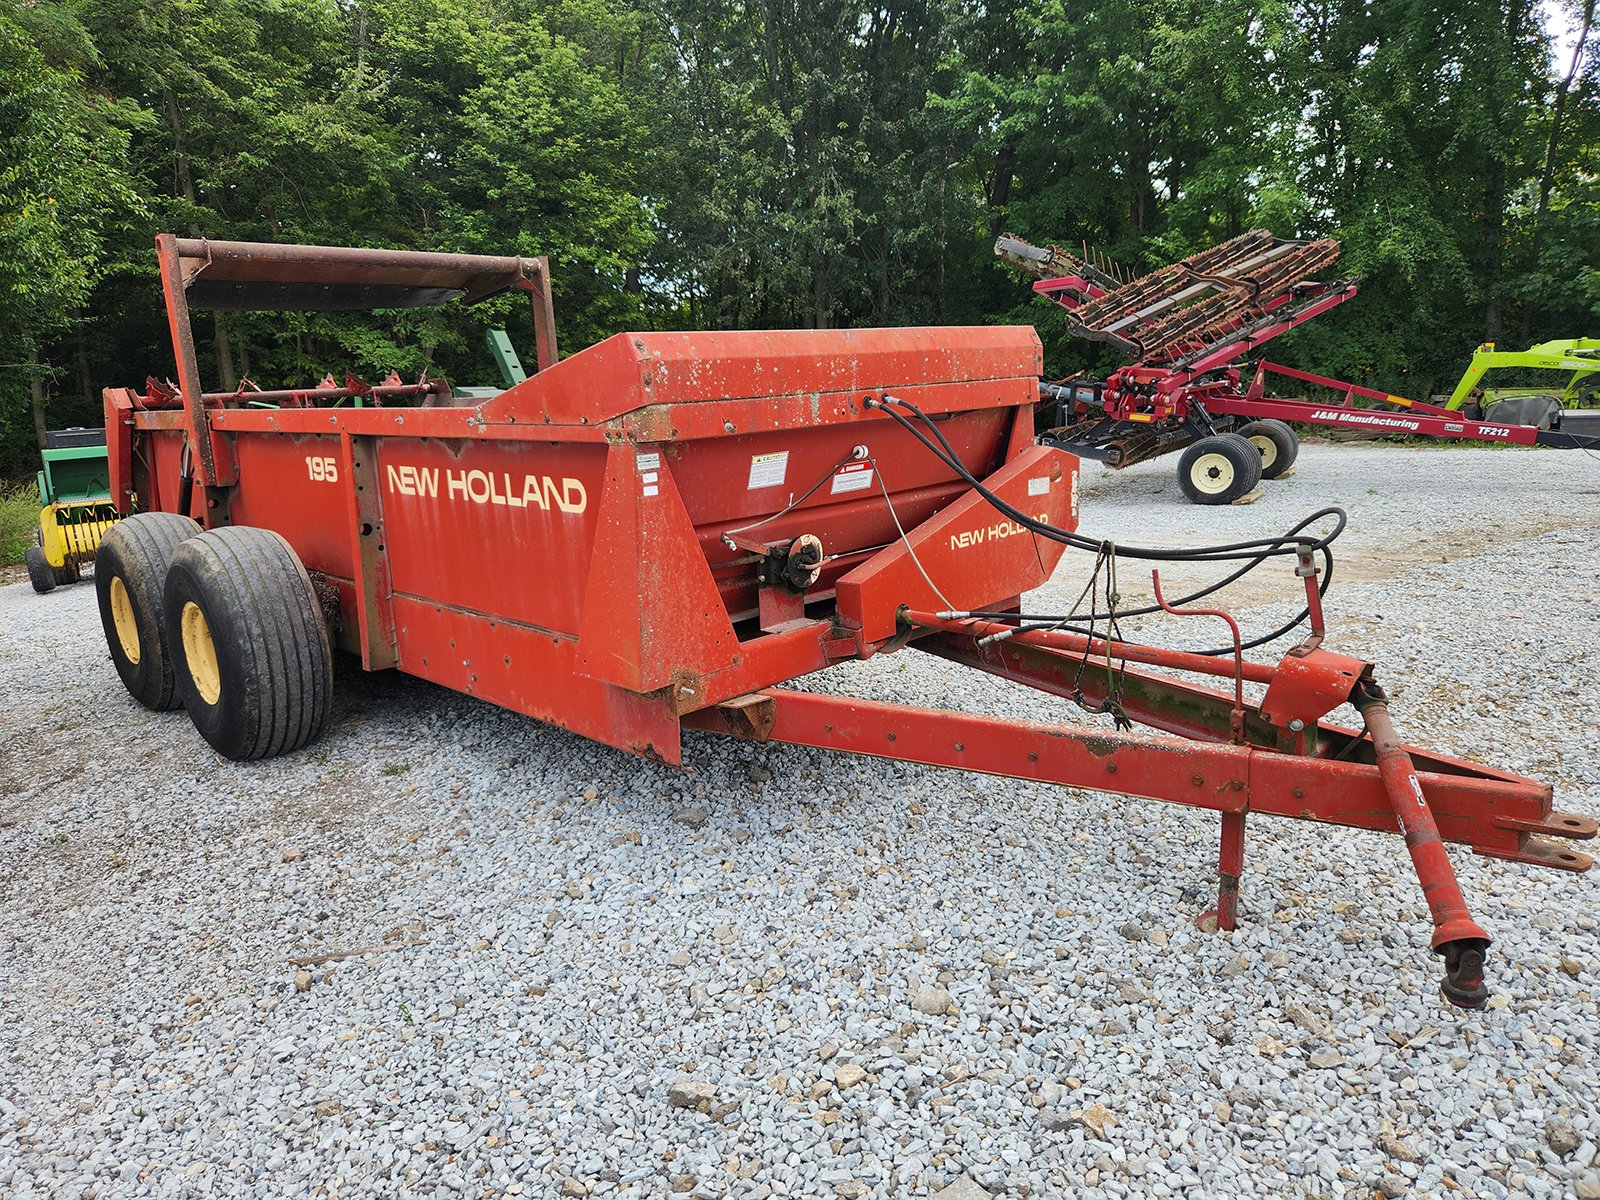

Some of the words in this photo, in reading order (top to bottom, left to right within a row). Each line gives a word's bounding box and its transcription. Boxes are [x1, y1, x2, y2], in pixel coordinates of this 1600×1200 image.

[1311, 411, 1338, 421] J&M
[1340, 412, 1420, 431] Manufacturing
[1478, 426, 1510, 437] TF212
[306, 456, 338, 483] 195
[846, 464, 865, 472] DANGER
[387, 465, 439, 498] NEW
[447, 469, 588, 514] HOLLAND
[950, 528, 985, 551] NEW
[988, 513, 1050, 541] HOLLD
